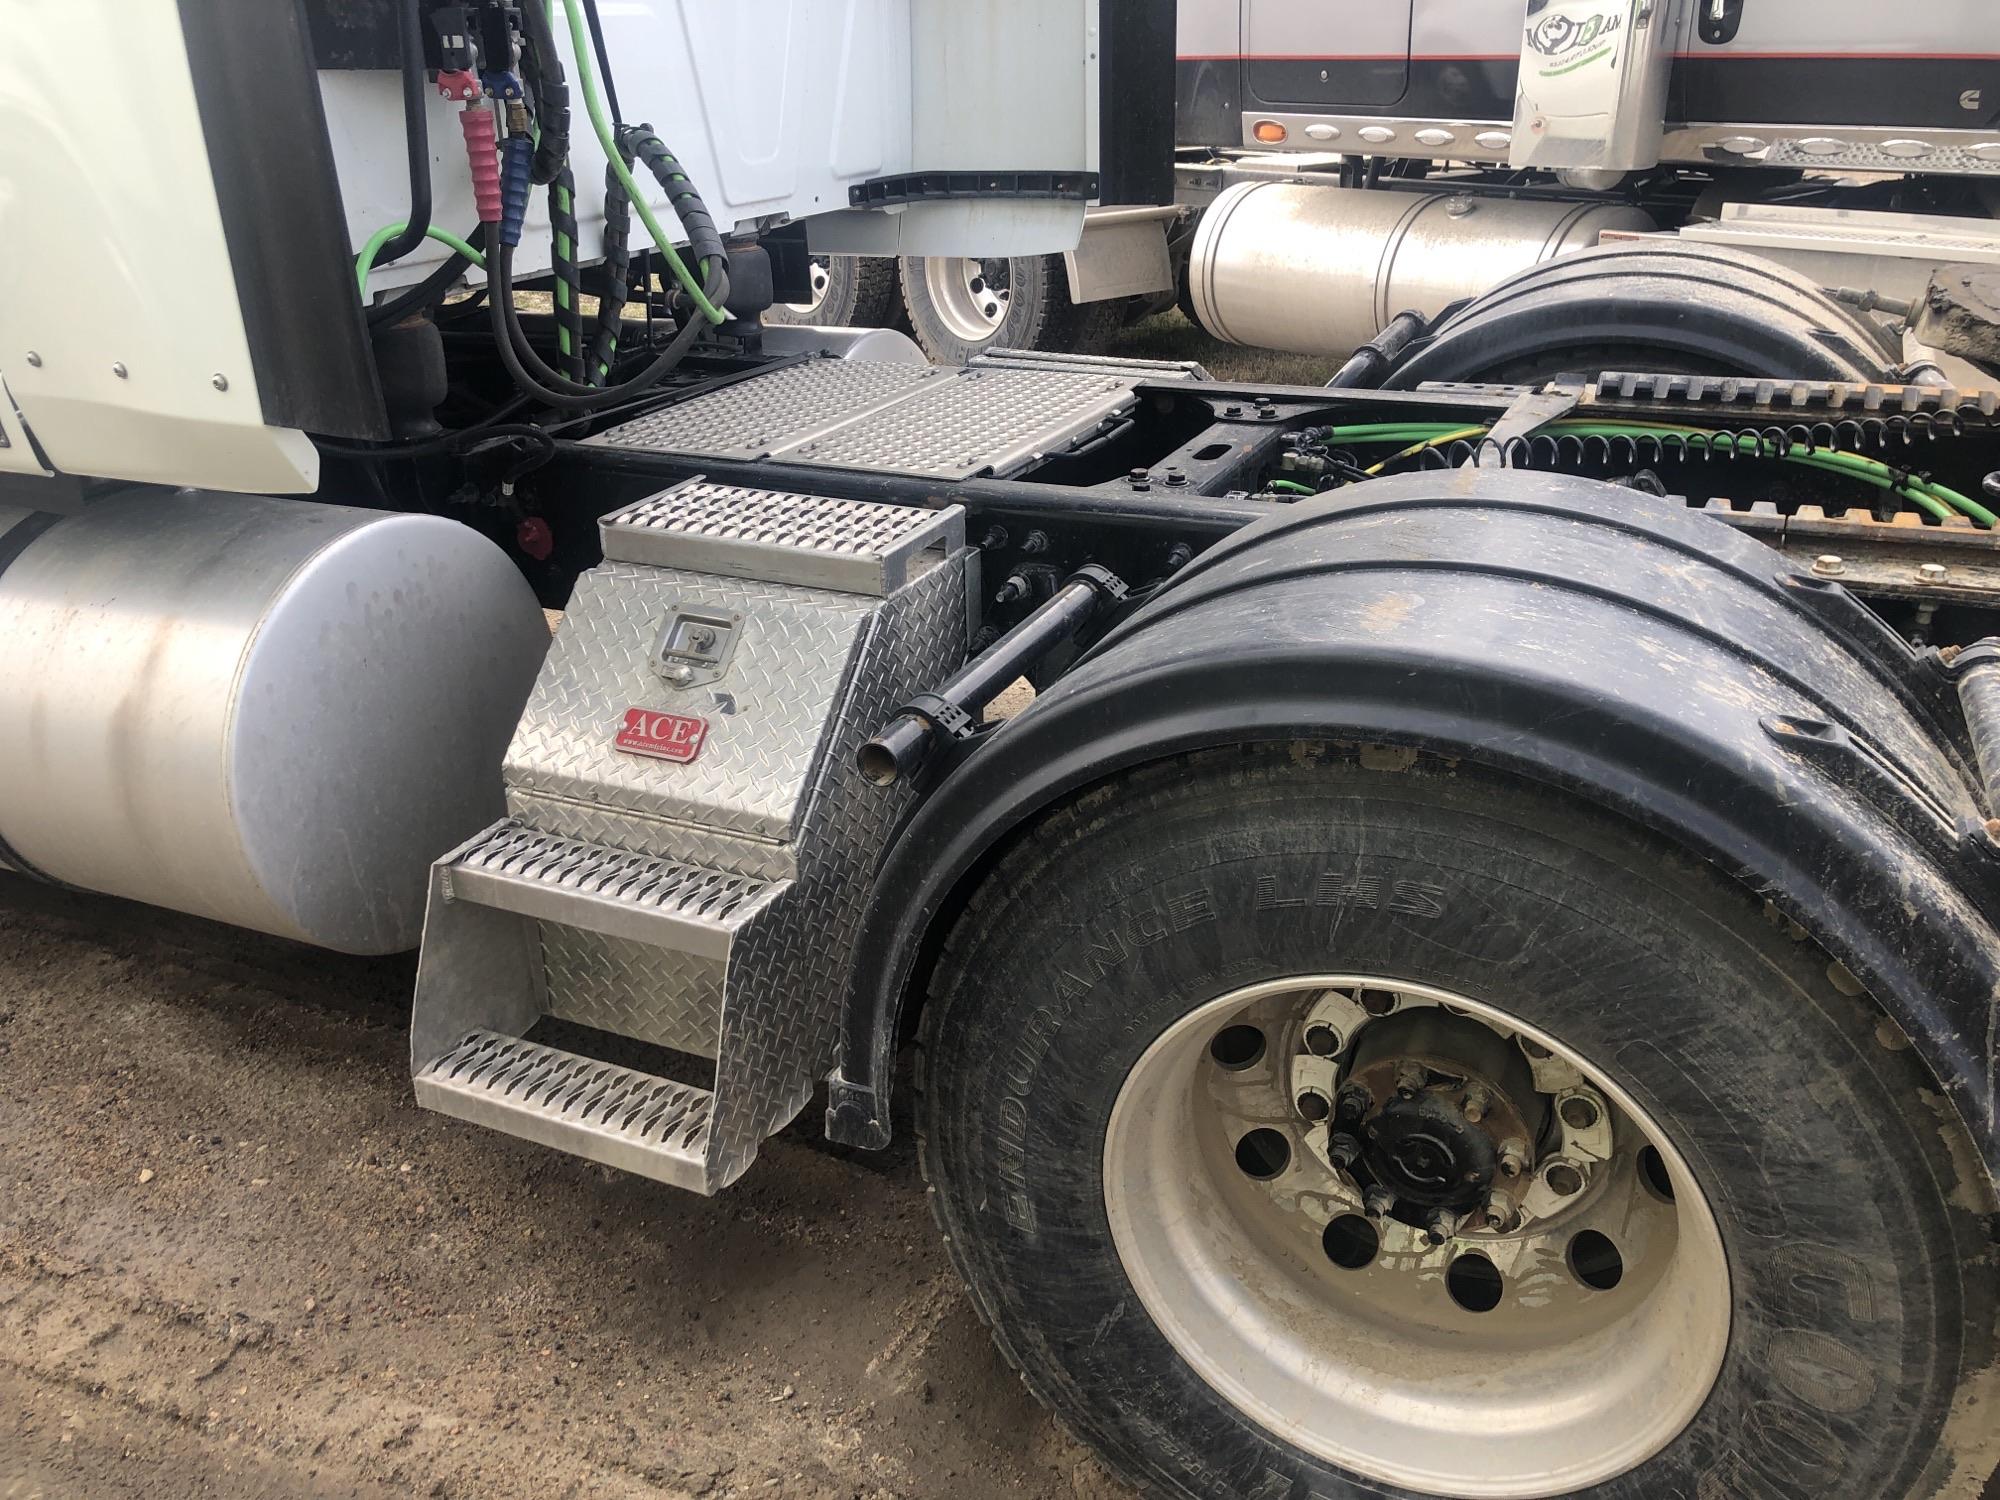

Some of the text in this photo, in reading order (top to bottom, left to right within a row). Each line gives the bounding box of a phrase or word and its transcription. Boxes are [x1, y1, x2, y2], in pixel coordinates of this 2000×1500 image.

[628, 713, 693, 744] ACE
[997, 872, 1445, 1235] ENDURANCE LHS
